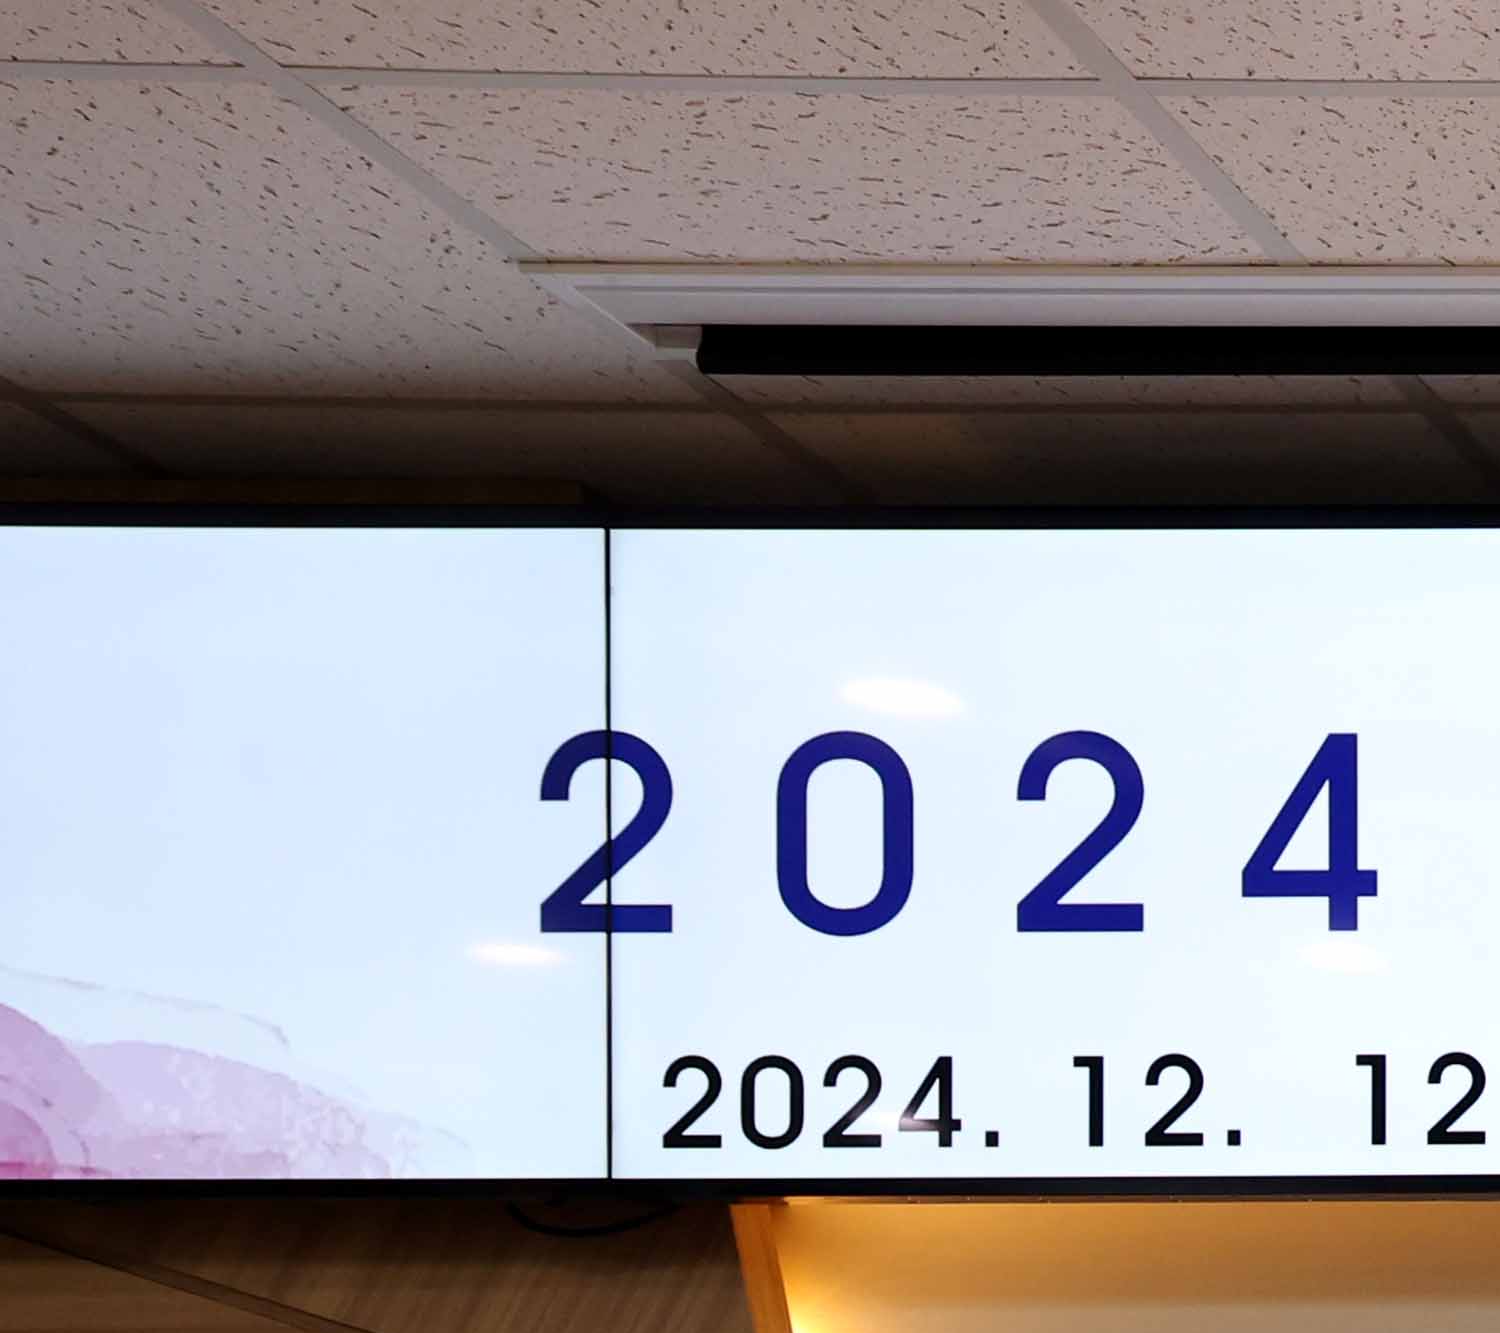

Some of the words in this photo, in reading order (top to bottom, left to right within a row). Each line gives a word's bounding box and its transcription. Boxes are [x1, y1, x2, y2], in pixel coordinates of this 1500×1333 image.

[540, 731, 1377, 936] 2024
[663, 1055, 998, 1149] 2024.
[1074, 1054, 1240, 1146] 12.
